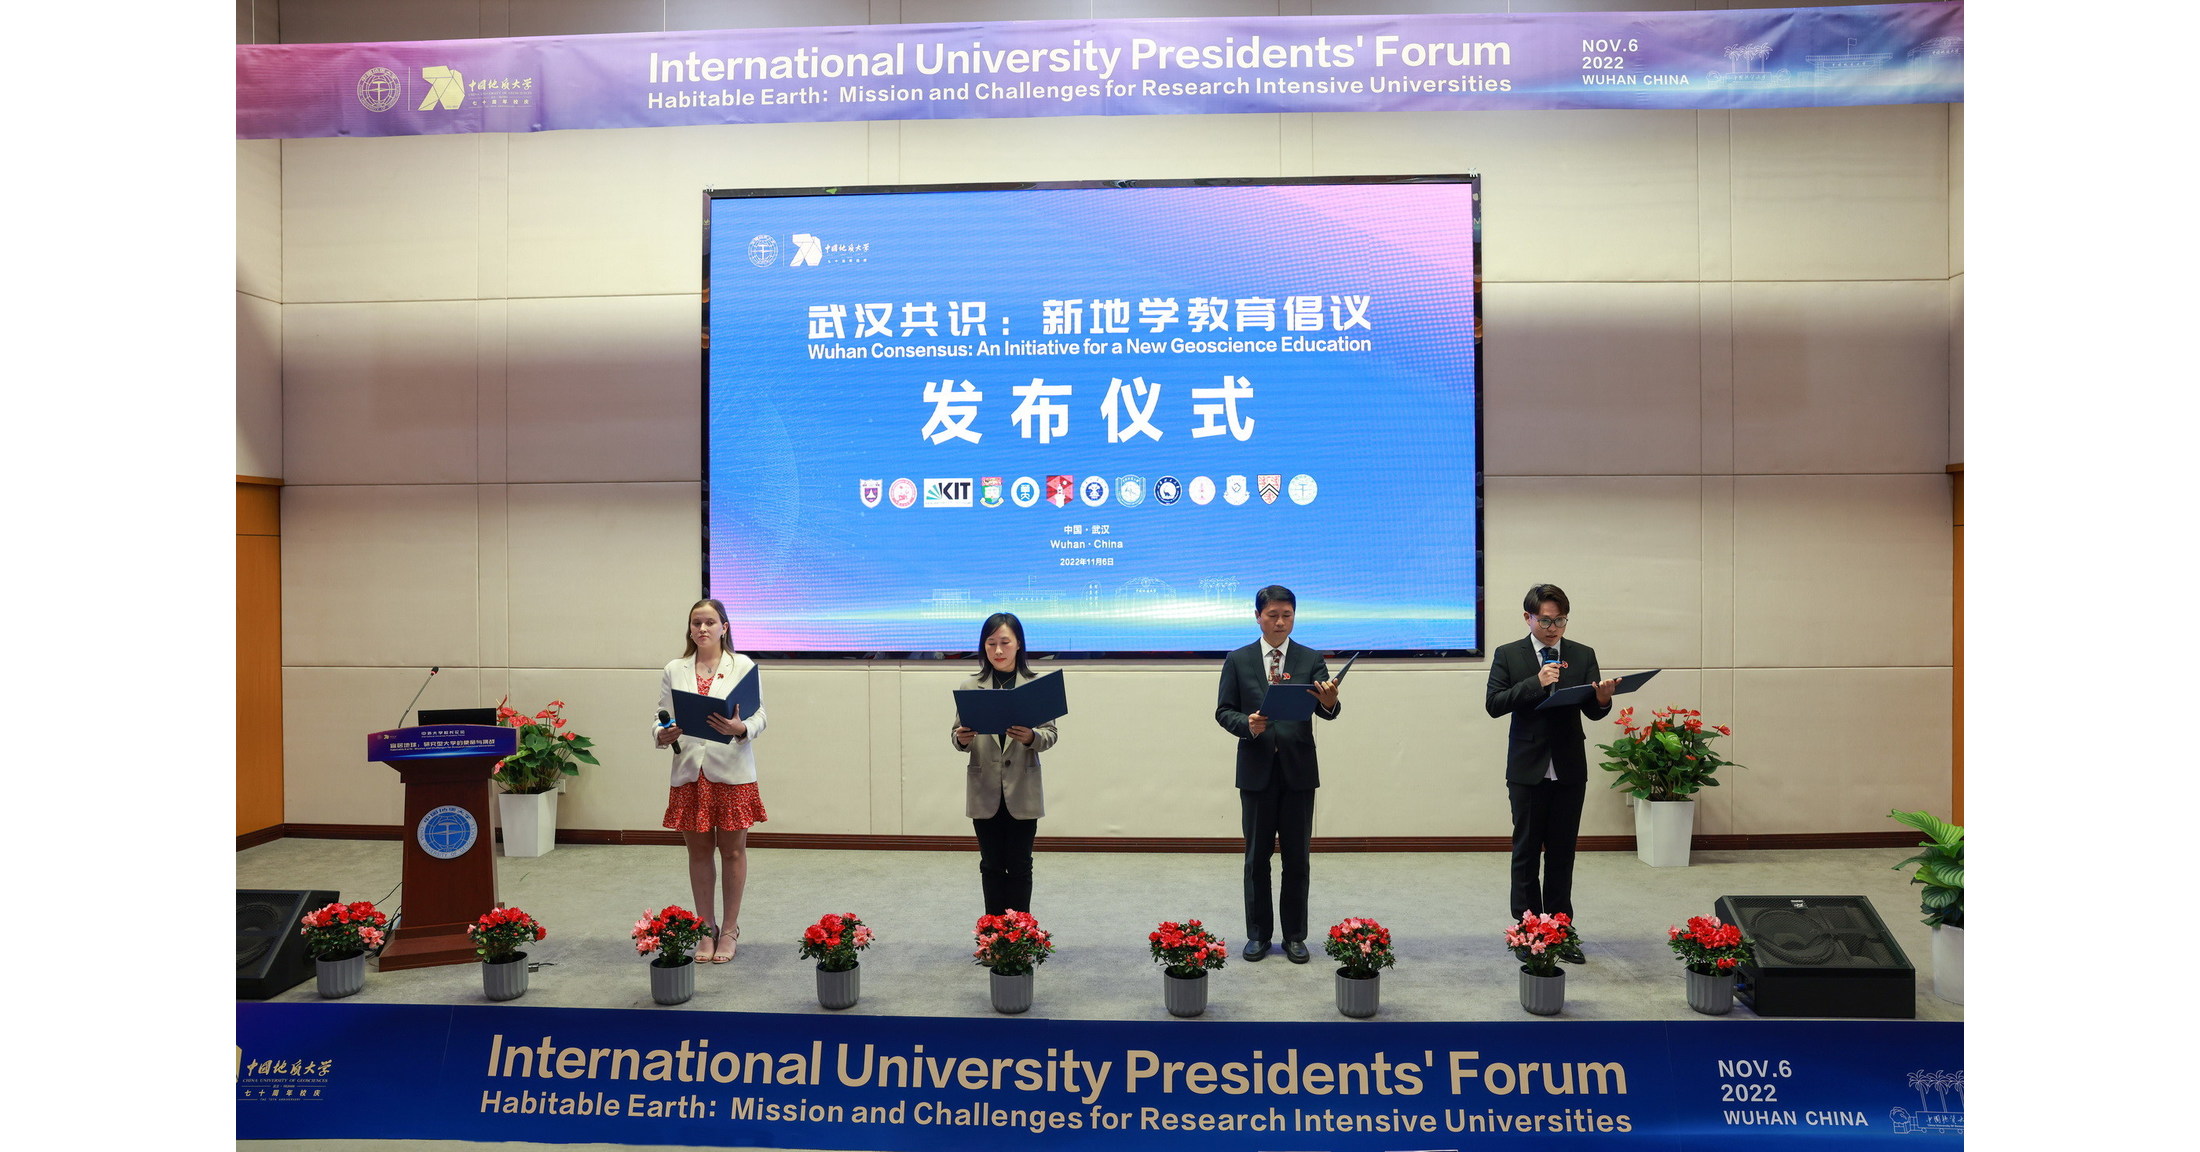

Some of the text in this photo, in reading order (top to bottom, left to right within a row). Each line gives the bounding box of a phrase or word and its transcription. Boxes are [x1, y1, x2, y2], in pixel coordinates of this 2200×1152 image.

[1582, 38, 1639, 53] NOV.6
[648, 34, 1512, 85] International University Presidents' Forum
[1582, 56, 1624, 70] 2022
[1582, 74, 1690, 86] WUHAN CHINA
[648, 76, 1512, 109] Habitable Earth: Mission and Challenges for Research Intensive Universities
[807, 335, 1372, 360] Wuhan Consensus: An Initiative for a New Geoscience Education
[921, 376, 1255, 445] 发布仪式
[938, 481, 971, 500] KIT
[1050, 539, 1086, 549] Wuhan
[1093, 539, 1124, 549] China
[1060, 557, 1114, 566] 2022年11月6日
[246, 1058, 333, 1077] 中国地质大学
[487, 1034, 1628, 1104] International University Presidents' Forum
[1718, 1059, 1792, 1078] NOV.6
[1720, 1083, 1778, 1102] 2022
[480, 1090, 1632, 1134] Habitable Earth: Mission and Challenges for Research Intensive Universities
[1723, 1110, 1869, 1126] WUHAN CHINA
